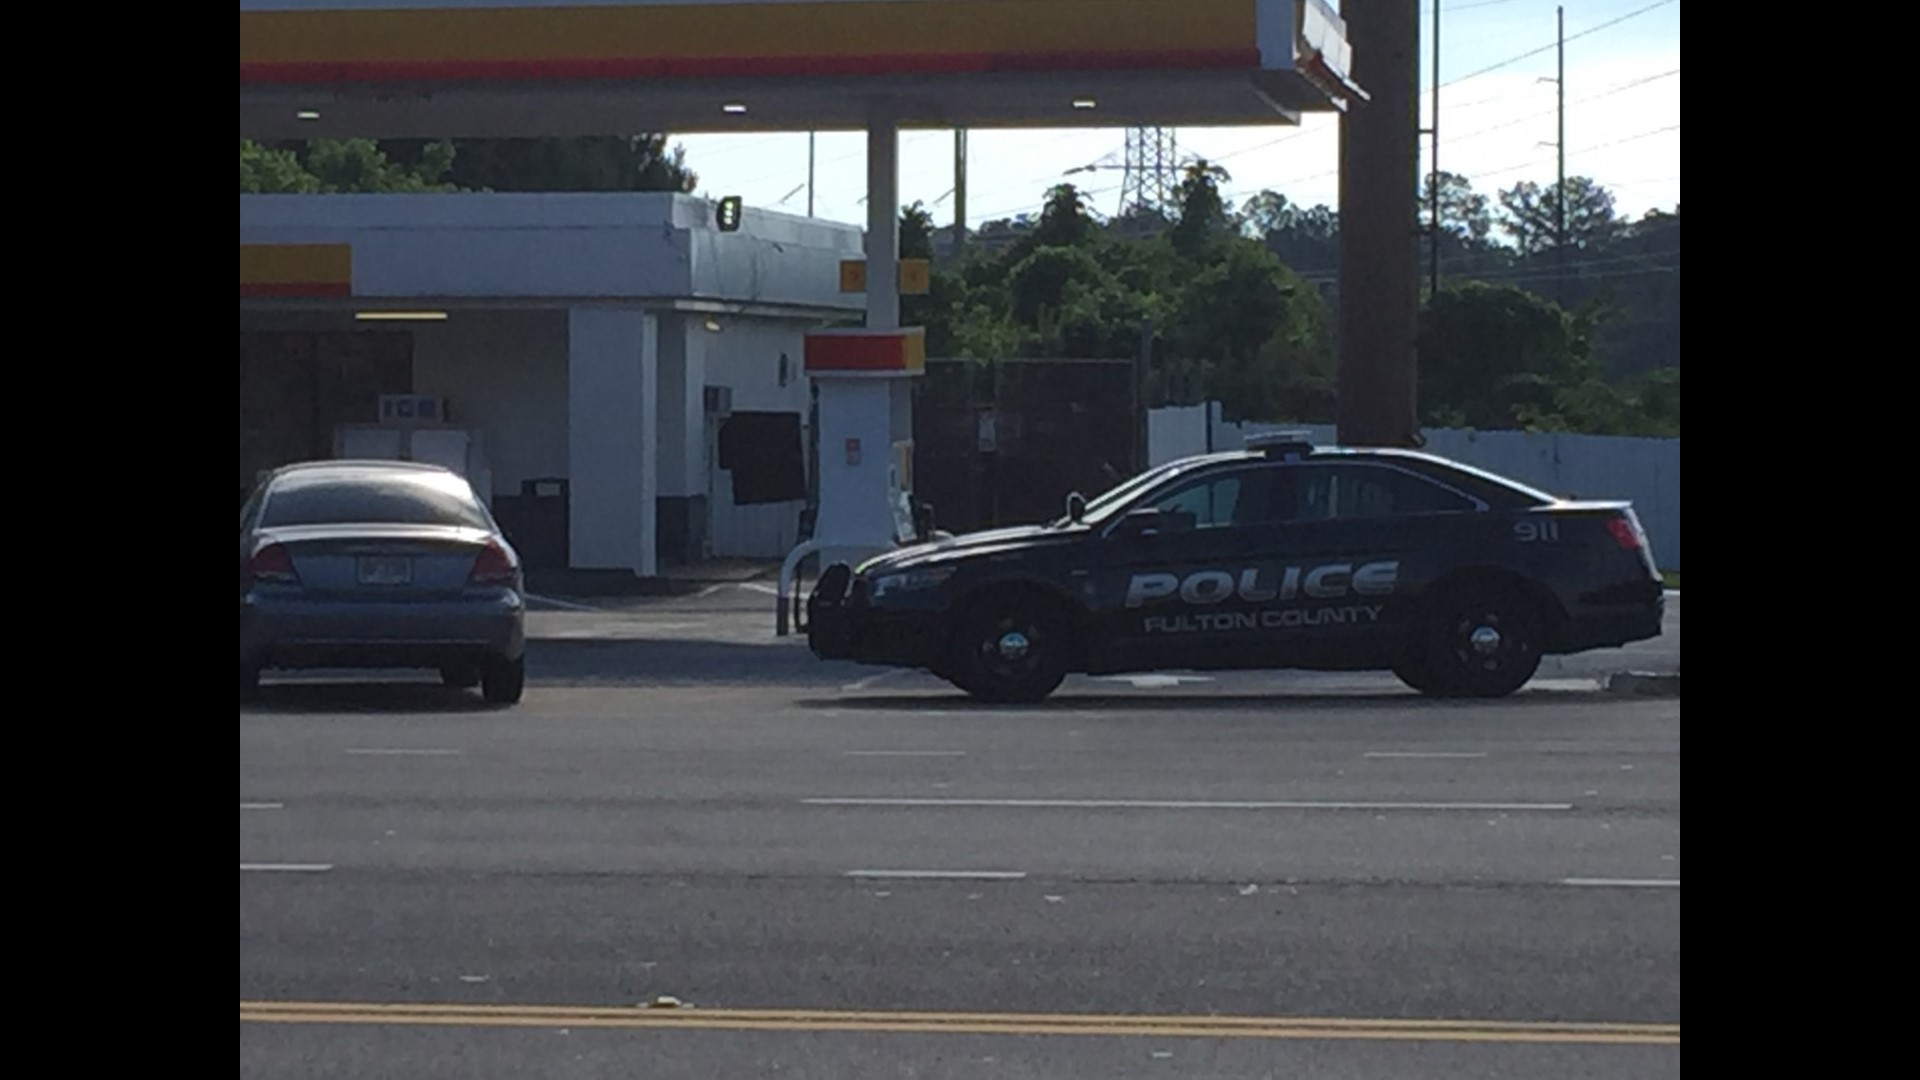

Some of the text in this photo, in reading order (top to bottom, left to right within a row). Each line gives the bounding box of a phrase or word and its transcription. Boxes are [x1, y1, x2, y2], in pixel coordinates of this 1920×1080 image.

[1513, 521, 1558, 542] 911
[1125, 561, 1399, 608] POLICE
[1144, 605, 1384, 634] FULTON COUNTY
